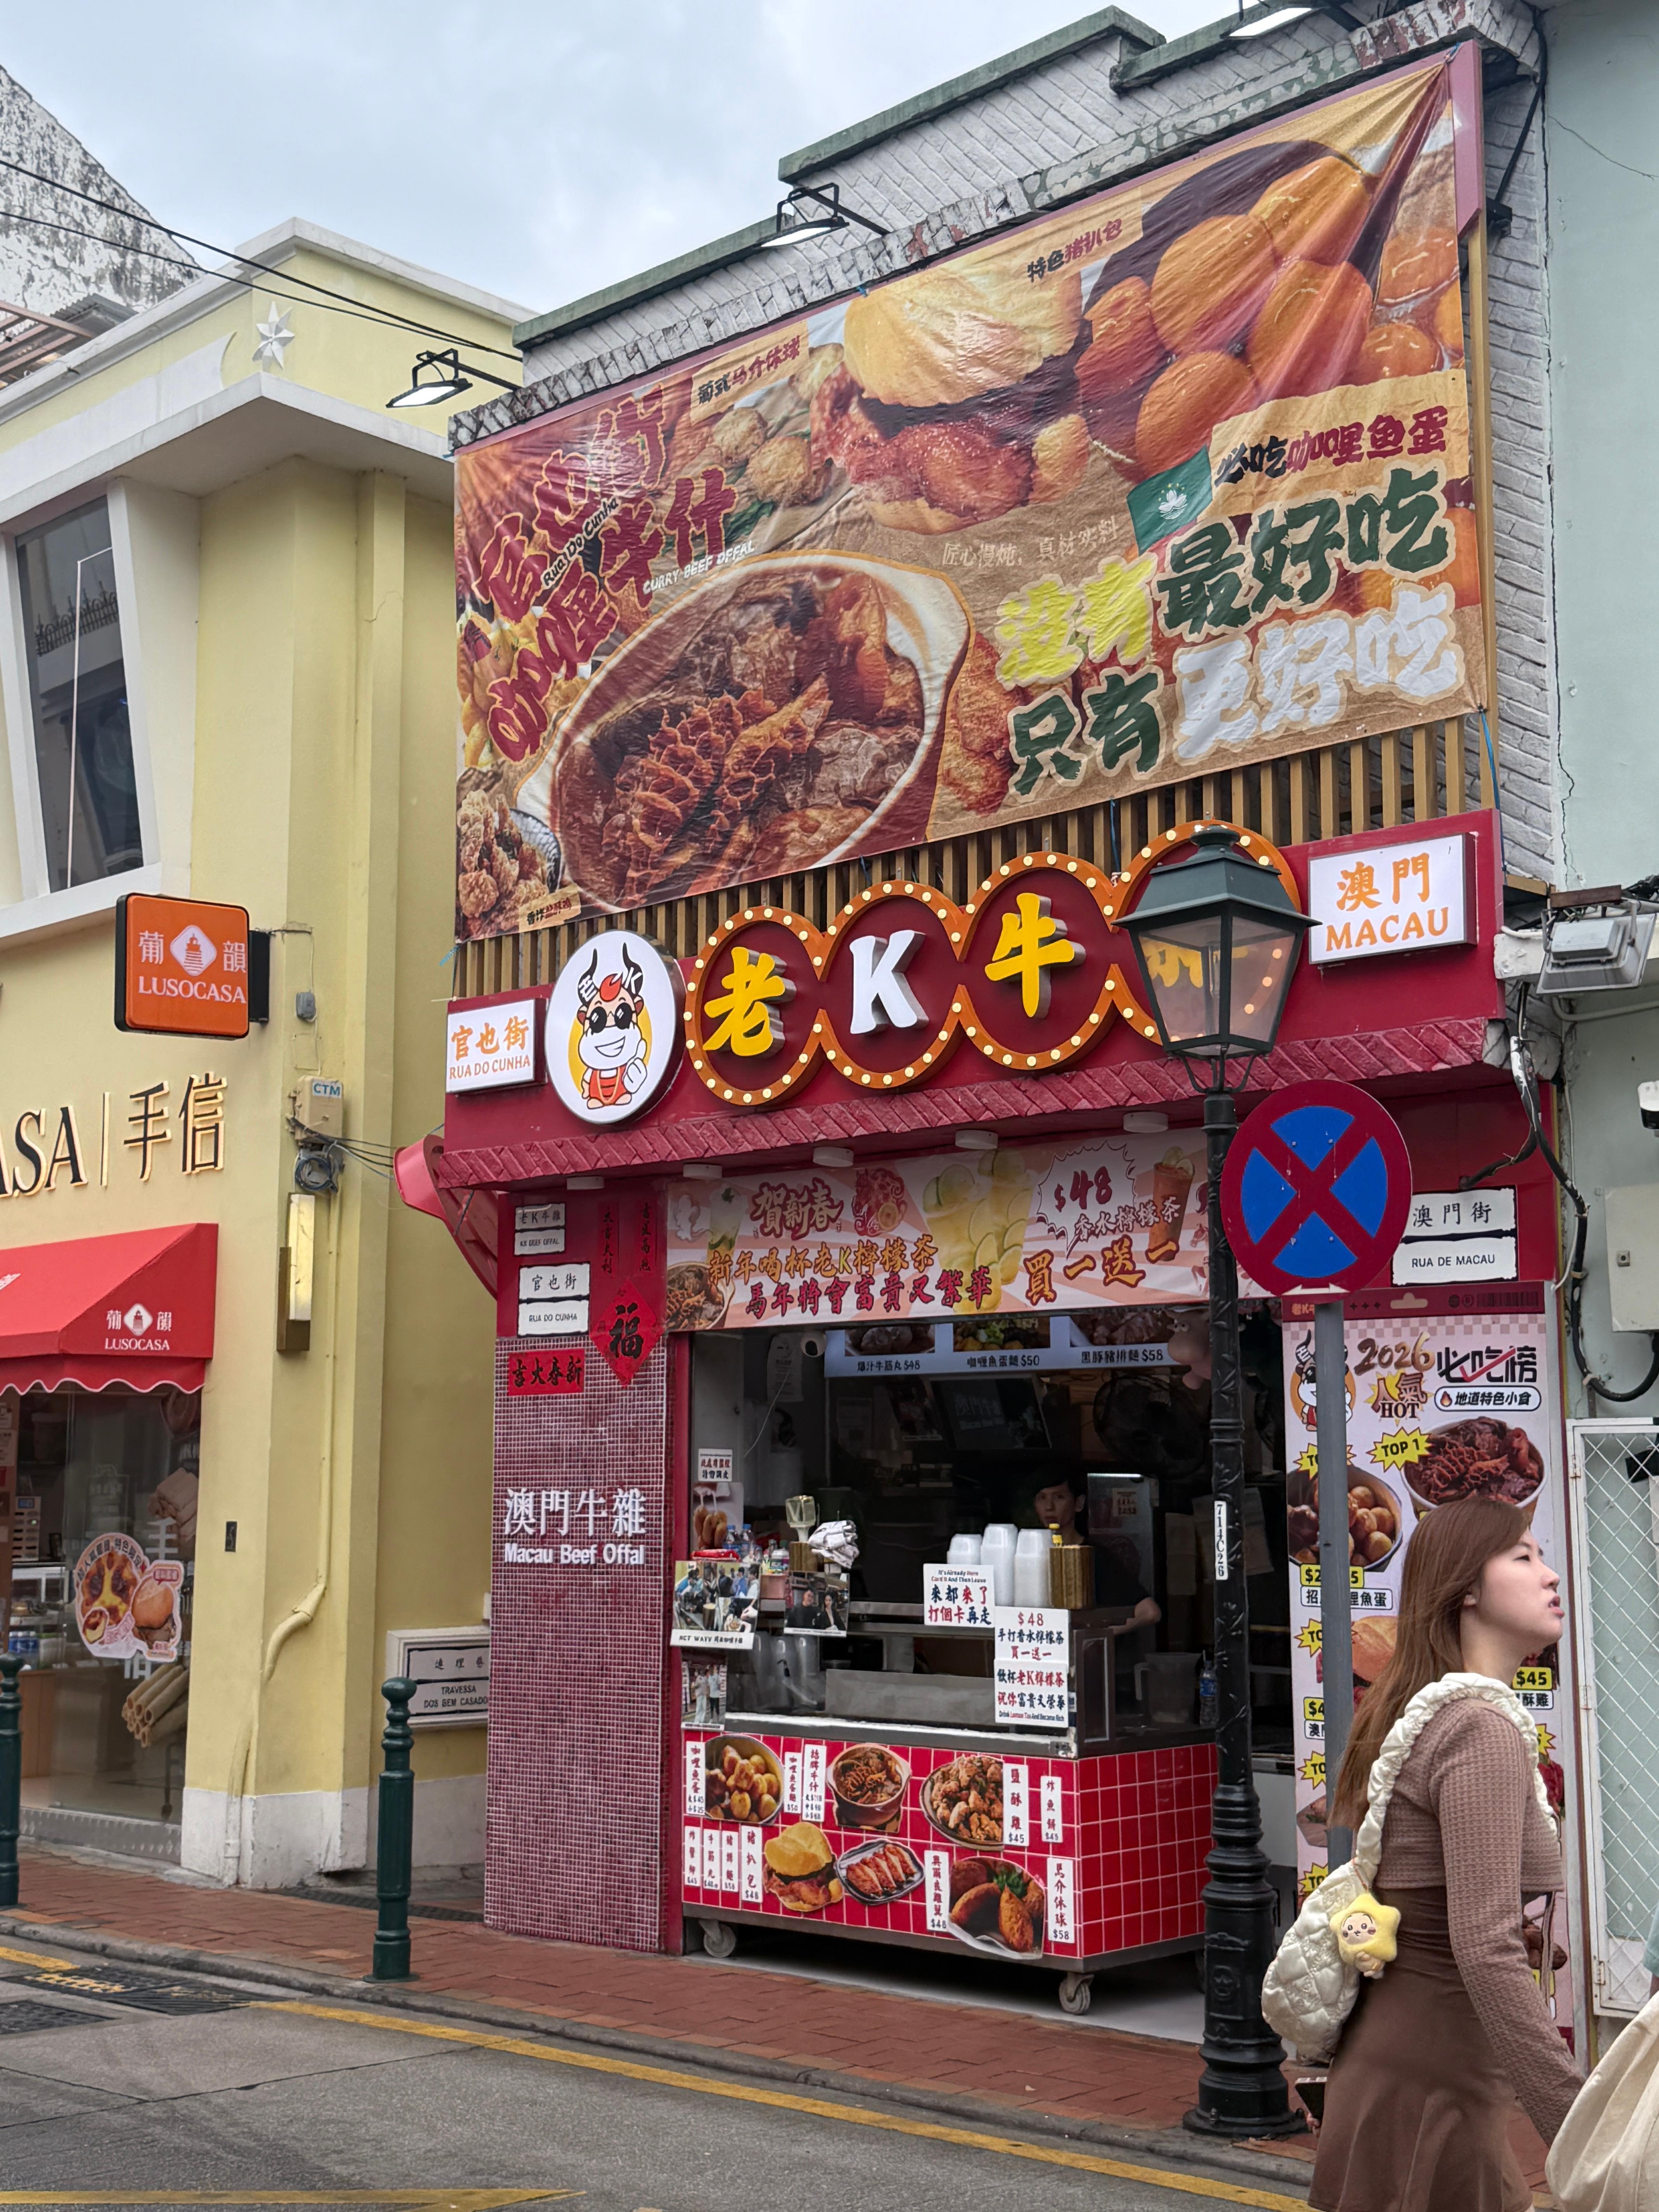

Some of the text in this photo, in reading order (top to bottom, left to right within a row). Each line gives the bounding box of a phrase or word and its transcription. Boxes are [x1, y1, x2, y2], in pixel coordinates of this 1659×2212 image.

[544, 498, 618, 587] Rua Do Cunha
[642, 540, 755, 595] CURRY BEEF OFFAL
[1336, 852, 1430, 912] 澳門
[1326, 906, 1449, 952] MACAU
[139, 930, 247, 973] 葡 韻
[138, 976, 247, 1004] LUSOCASA
[451, 1015, 529, 1061] 官也街
[449, 1054, 531, 1080] RUA DO CUNHA
[313, 1083, 341, 1096] CTM
[123, 1071, 228, 1182] 手信
[1054, 1166, 1113, 1212] $48
[750, 1177, 843, 1240] 賀新春
[1074, 1196, 1182, 1242] 香水檸檬茶
[1412, 1201, 1492, 1228] 澳門街
[709, 1233, 938, 1288] 新年喝杯老K檸檬茶
[1023, 1234, 1180, 1306] 買一送一
[1412, 1254, 1496, 1268] RUA DE MACAU
[532, 1273, 577, 1291] 官也街
[746, 1265, 993, 1319] 馬年將會富貴又繁華
[529, 1313, 577, 1322] RUA DO CUNHA
[609, 1302, 644, 1359] 福
[105, 1338, 170, 1350] LUSOCASA
[1142, 1348, 1163, 1362] $58
[1354, 1331, 1436, 1376] 2026
[904, 1359, 920, 1370] $48
[1021, 1354, 1040, 1367] $50
[1437, 1345, 1537, 1383] 必吃榜
[1371, 1372, 1428, 1413] 人氣
[1455, 1392, 1532, 1407] 地道特色小食
[1380, 1401, 1419, 1419] HOT
[1381, 1438, 1420, 1457] TOP 1
[504, 1487, 647, 1537] 澳門牛雜
[505, 1542, 645, 1565] Macau Beef Offal
[931, 1584, 988, 1605] 來都來了
[928, 1604, 992, 1625] 打個卡再走
[1018, 1611, 1044, 1626] $48
[1011, 1645, 1052, 1661] 買一送一
[1516, 1669, 1547, 1687] $45
[441, 1685, 477, 1695] TRAVESSA
[1515, 1693, 1549, 1707] 酥雞
[424, 1700, 439, 1708] DOS
[460, 1696, 488, 1705] CASADO
[1309, 1700, 1324, 1717] $4
[1008, 1832, 1025, 1844] $45
[747, 1830, 757, 1888] 豬扒包
[745, 1889, 759, 1900] $48
[1054, 1863, 1068, 1927] 馬介休球
[931, 1918, 947, 1929] $48
[1052, 1928, 1070, 1941] $58
